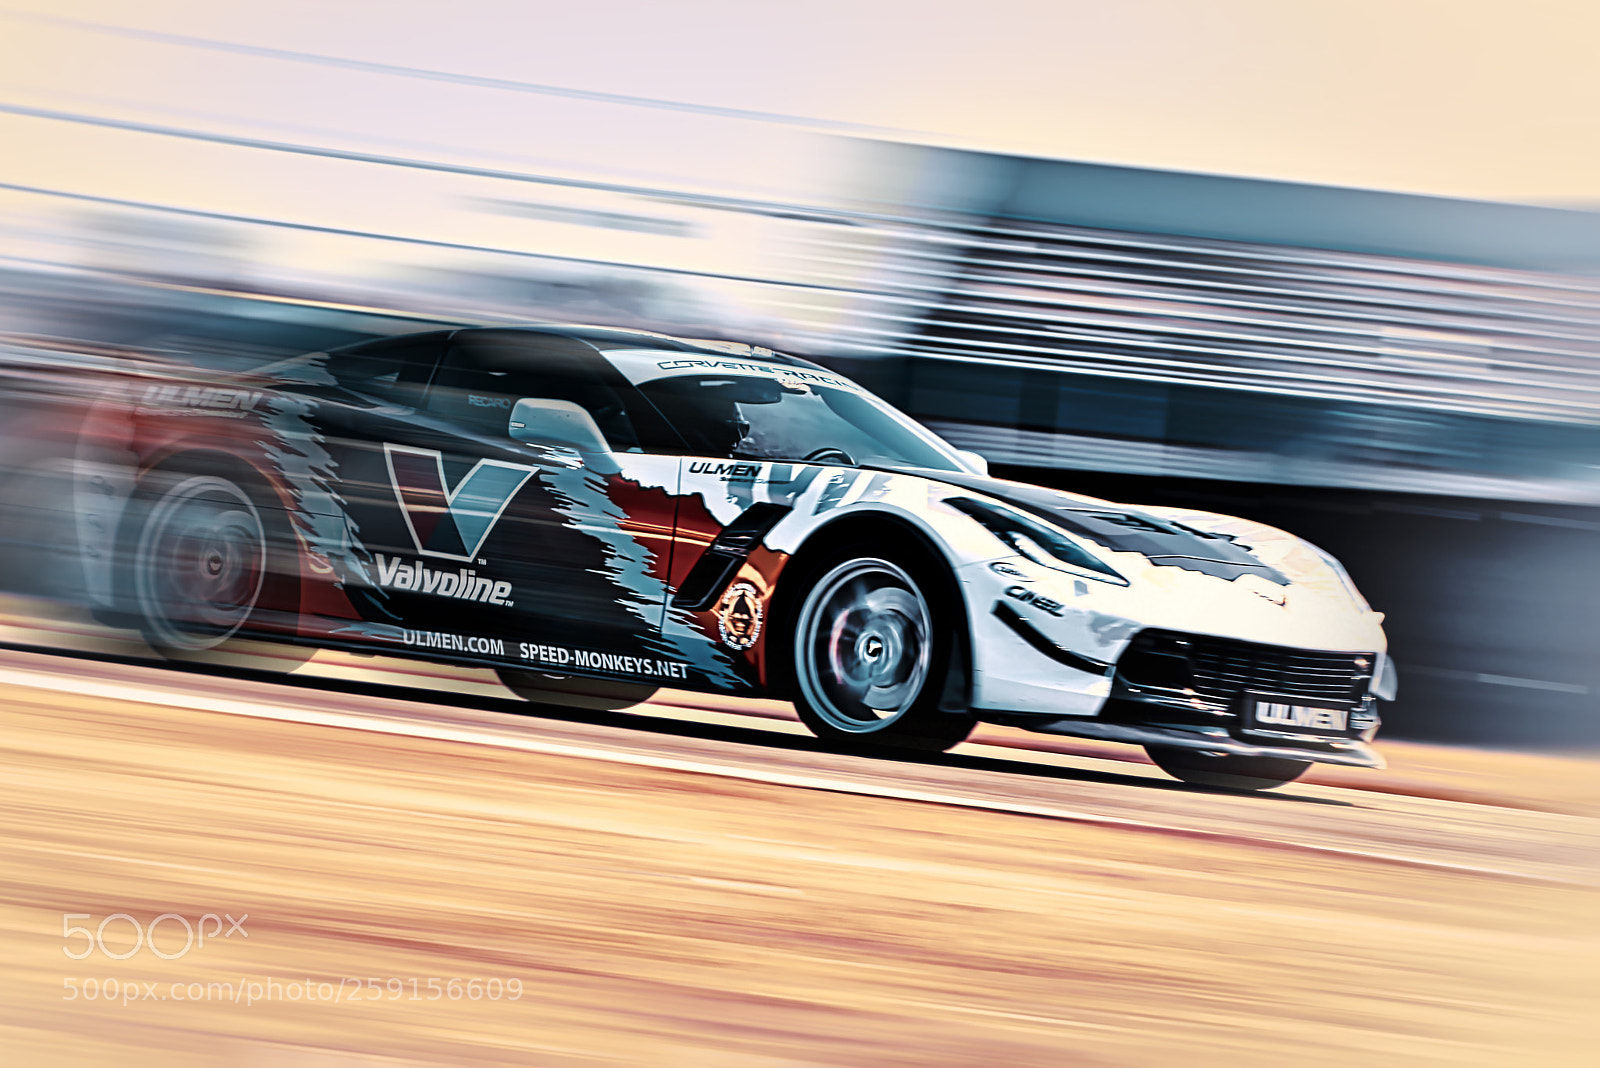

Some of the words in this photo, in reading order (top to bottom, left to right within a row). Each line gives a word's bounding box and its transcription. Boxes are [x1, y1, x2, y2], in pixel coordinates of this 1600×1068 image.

[141, 385, 263, 410] ULMEN
[468, 394, 511, 409] RECARO
[688, 461, 763, 477] ULMEN
[375, 553, 512, 606] Valvoline
[402, 628, 505, 657] ULMEN.COM
[519, 642, 689, 679] SPEED-MONKEYS.NET
[1255, 701, 1349, 731] ULMEN
